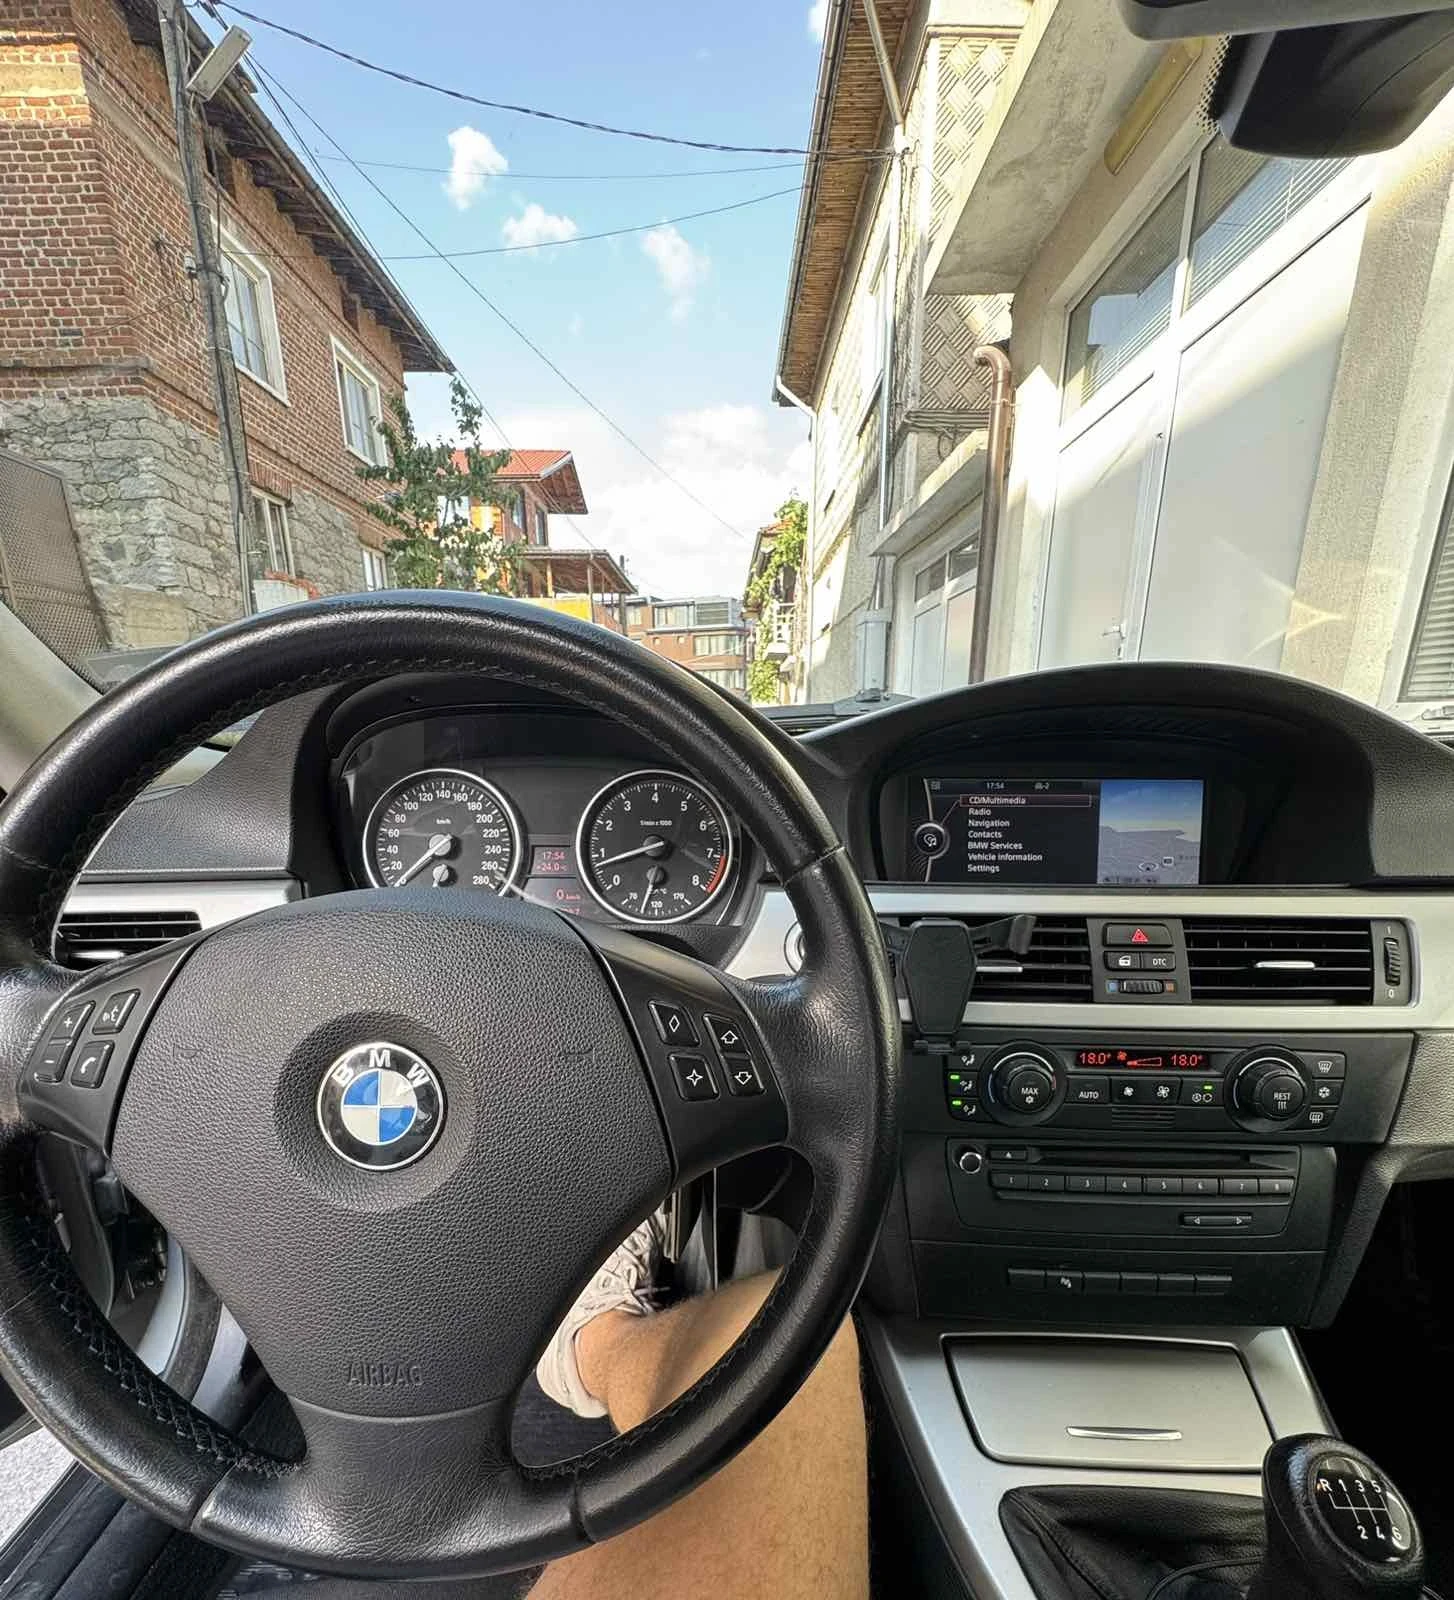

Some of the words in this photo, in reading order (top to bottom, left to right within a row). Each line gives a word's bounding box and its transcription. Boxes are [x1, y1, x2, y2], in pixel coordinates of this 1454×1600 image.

[419, 793, 433, 801] 120
[436, 790, 450, 799] 140
[453, 793, 468, 801] 160
[652, 792, 659, 802] 4
[969, 796, 1026, 805] CD/Multimedia
[403, 802, 418, 810] 100
[467, 802, 482, 811] 180
[624, 801, 632, 812] 3
[681, 801, 688, 811] 5
[968, 808, 992, 816] Radio
[394, 814, 406, 823] 80
[476, 814, 493, 823] 200
[605, 820, 613, 831] 2
[700, 820, 707, 831] 6
[968, 819, 1010, 828] Navigation
[388, 828, 400, 838] 60
[483, 829, 500, 838] 220
[968, 830, 1003, 838] Contacts
[387, 845, 399, 854] 40
[485, 845, 501, 854] 240
[968, 842, 988, 850] BMW
[990, 842, 1023, 850] Services
[600, 848, 605, 858] 1
[707, 848, 714, 859] 7
[968, 853, 996, 861] Vehicle
[998, 853, 1042, 861] Information
[391, 861, 403, 870] 20
[481, 861, 498, 870] 260
[968, 864, 1000, 873] Settings
[473, 876, 490, 885] 280
[613, 875, 621, 886] 0
[692, 876, 700, 886] 8
[556, 889, 564, 900] 0
[1152, 957, 1167, 966] DTC
[331, 1049, 431, 1087] BMW
[1021, 1087, 1039, 1096] MAX
[1079, 1090, 1099, 1099] AUTO
[1274, 1092, 1291, 1100] REST
[347, 1362, 423, 1387] AIRBAG
[1320, 1479, 1332, 1492] R
[1338, 1479, 1347, 1492] 1
[1355, 1479, 1365, 1493] 3
[1371, 1480, 1381, 1494] 5
[1357, 1525, 1368, 1540] 2
[1376, 1525, 1386, 1540] 4
[1391, 1527, 1402, 1540] 6
